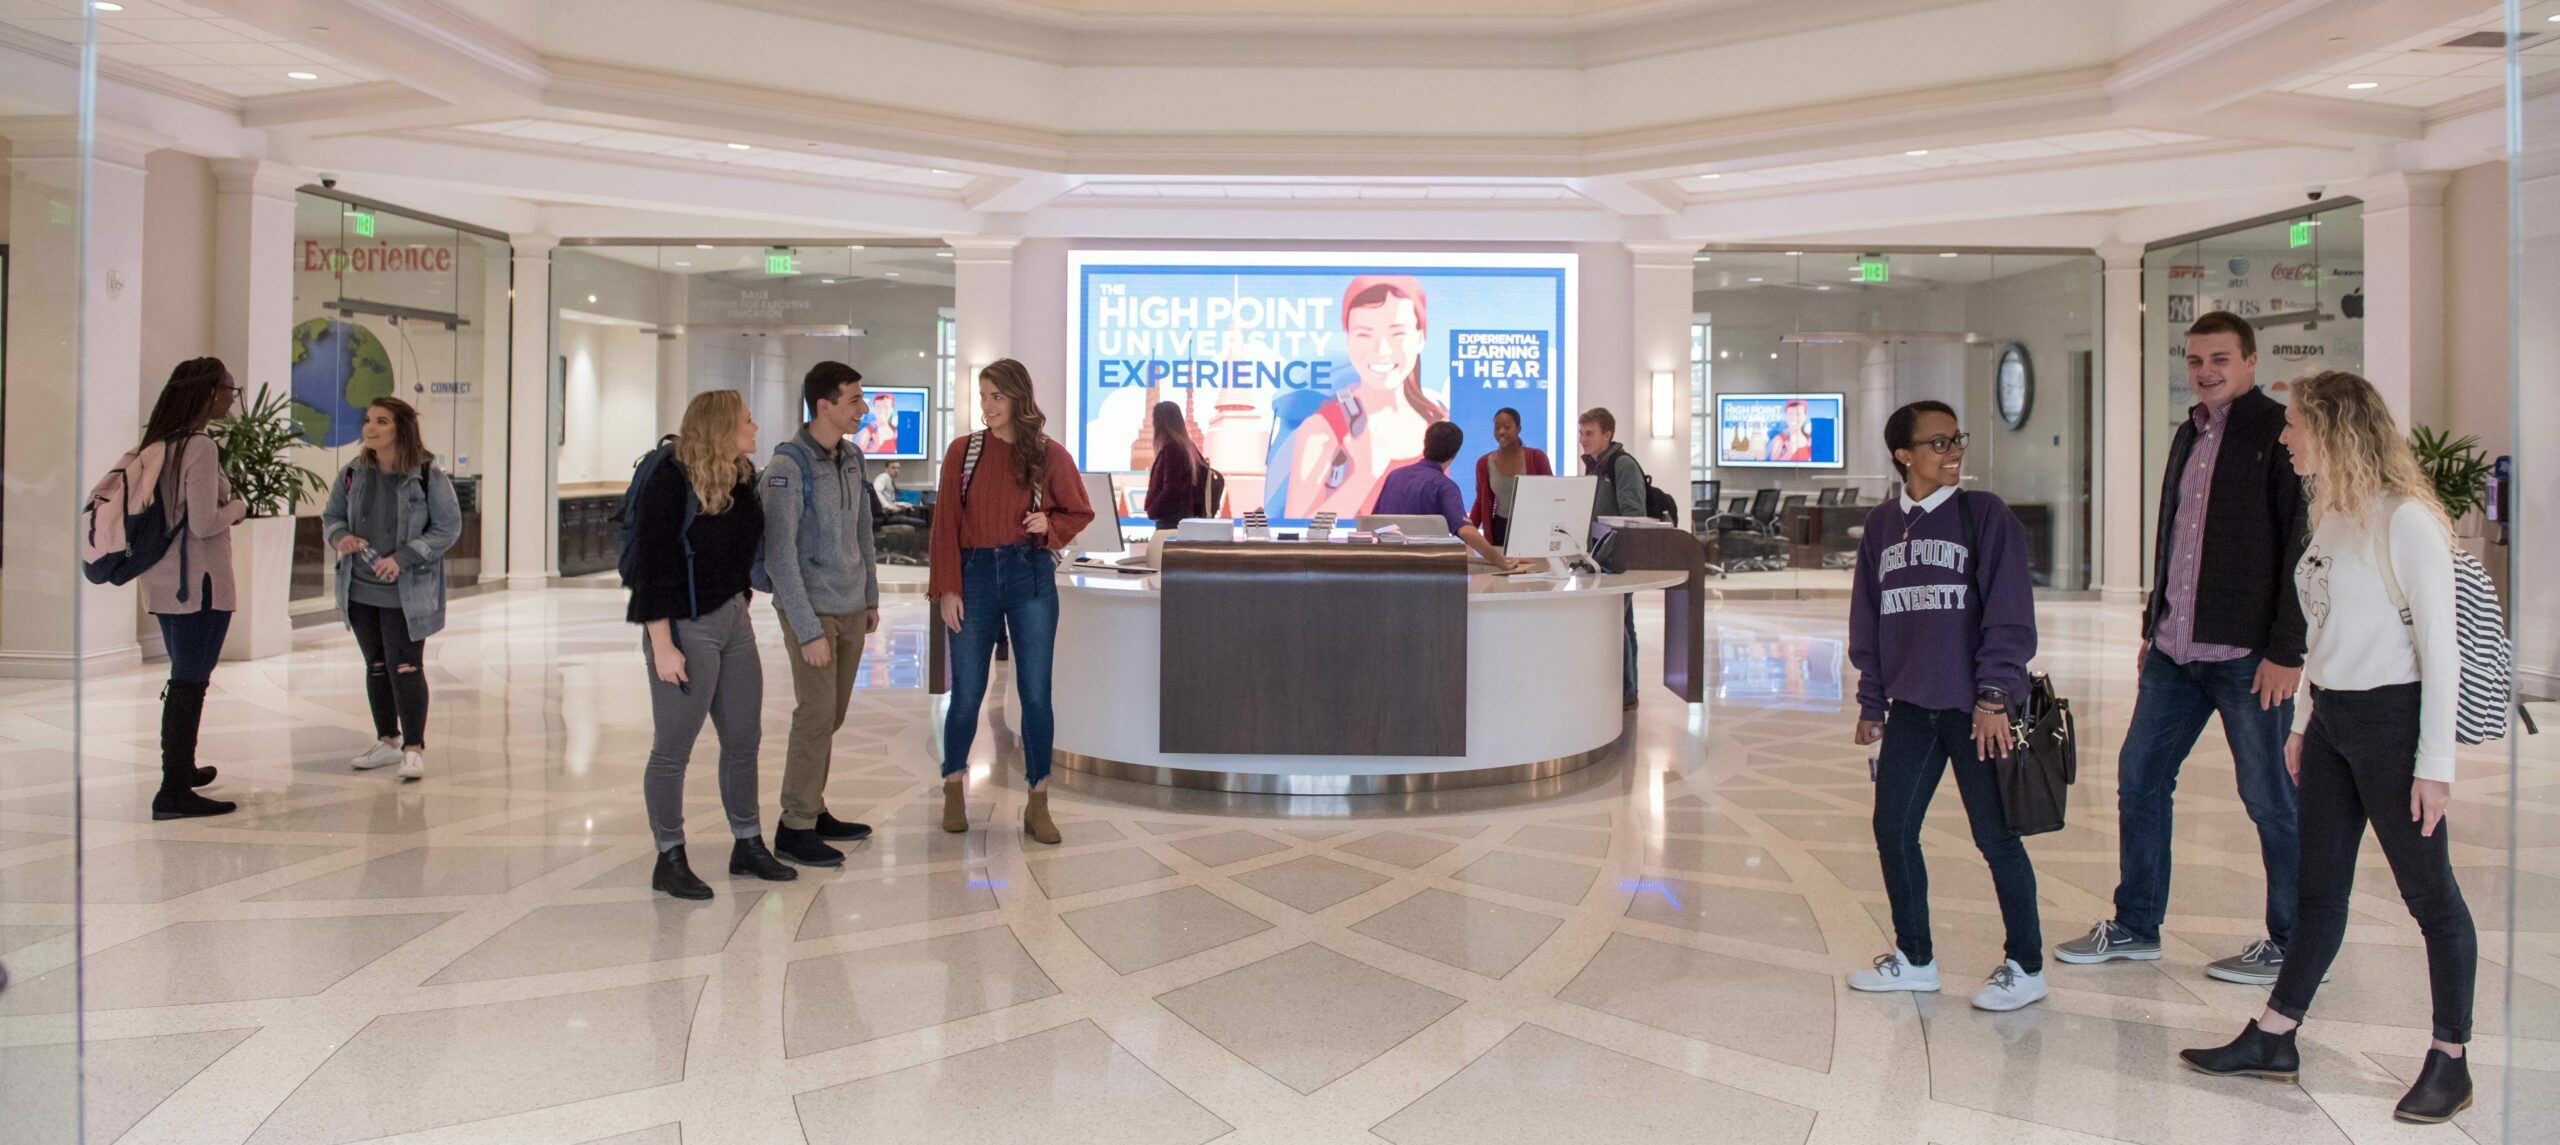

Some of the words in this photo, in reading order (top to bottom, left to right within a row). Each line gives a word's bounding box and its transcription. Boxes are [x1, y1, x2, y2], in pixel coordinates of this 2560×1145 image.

[304, 241, 450, 279] Experience
[1100, 284, 1126, 296] THE
[1100, 297, 1198, 328] HIGH
[1207, 297, 1333, 329] POINT
[1099, 330, 1333, 358] UNIVERSITY
[1458, 334, 1540, 345] EXPERIENTIAL
[2272, 344, 2324, 355] amazon
[1458, 345, 1540, 359] LEARNING
[1098, 360, 1333, 389] EXPERIENCE
[1474, 360, 1540, 378] HEAR
[430, 382, 471, 394] CONNECT
[1910, 539, 1969, 574] POINT
[1880, 584, 1968, 615] NIVERSITY
